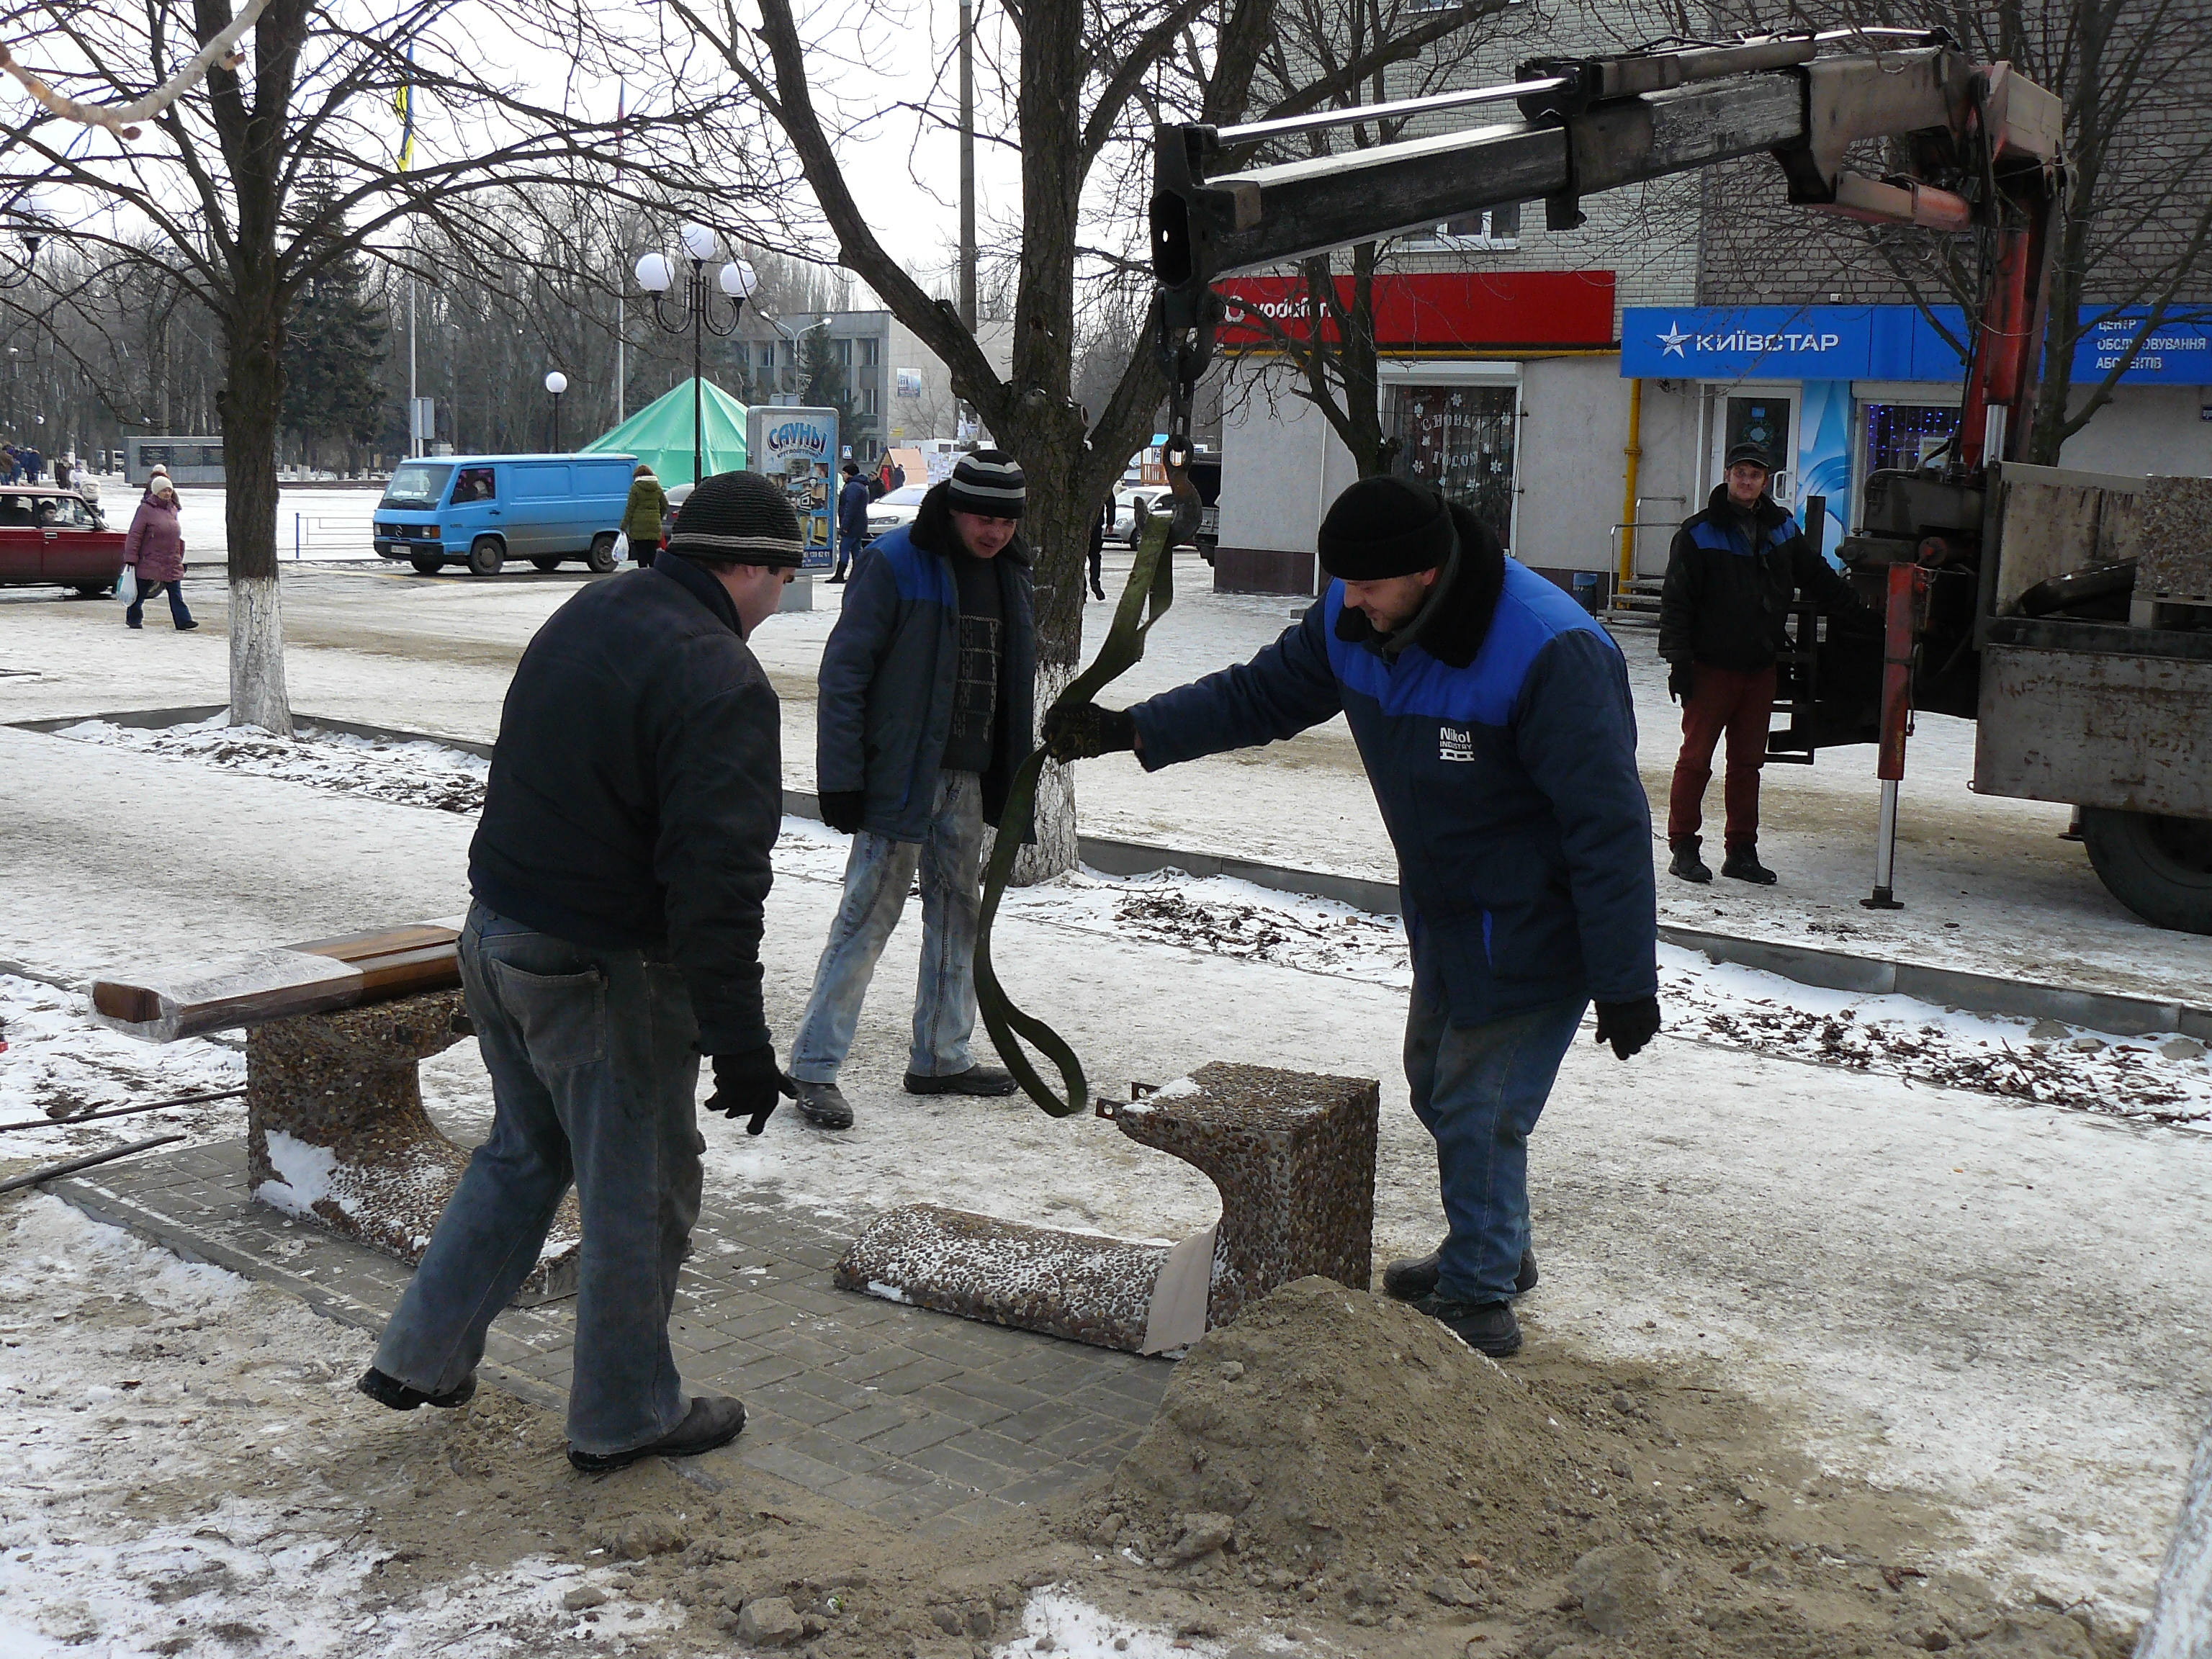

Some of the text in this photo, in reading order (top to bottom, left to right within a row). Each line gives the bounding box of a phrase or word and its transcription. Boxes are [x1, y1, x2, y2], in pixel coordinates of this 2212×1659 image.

[1252, 297, 1331, 318] vodafn
[1696, 330, 1839, 351] КИЇВСТАР
[2097, 338, 2206, 351] ОБСЛОВУВАННЯ
[2095, 356, 2162, 369] АБОЕНТІВ
[768, 422, 827, 454] САУНЫ
[1440, 727, 1470, 743] Nikol
